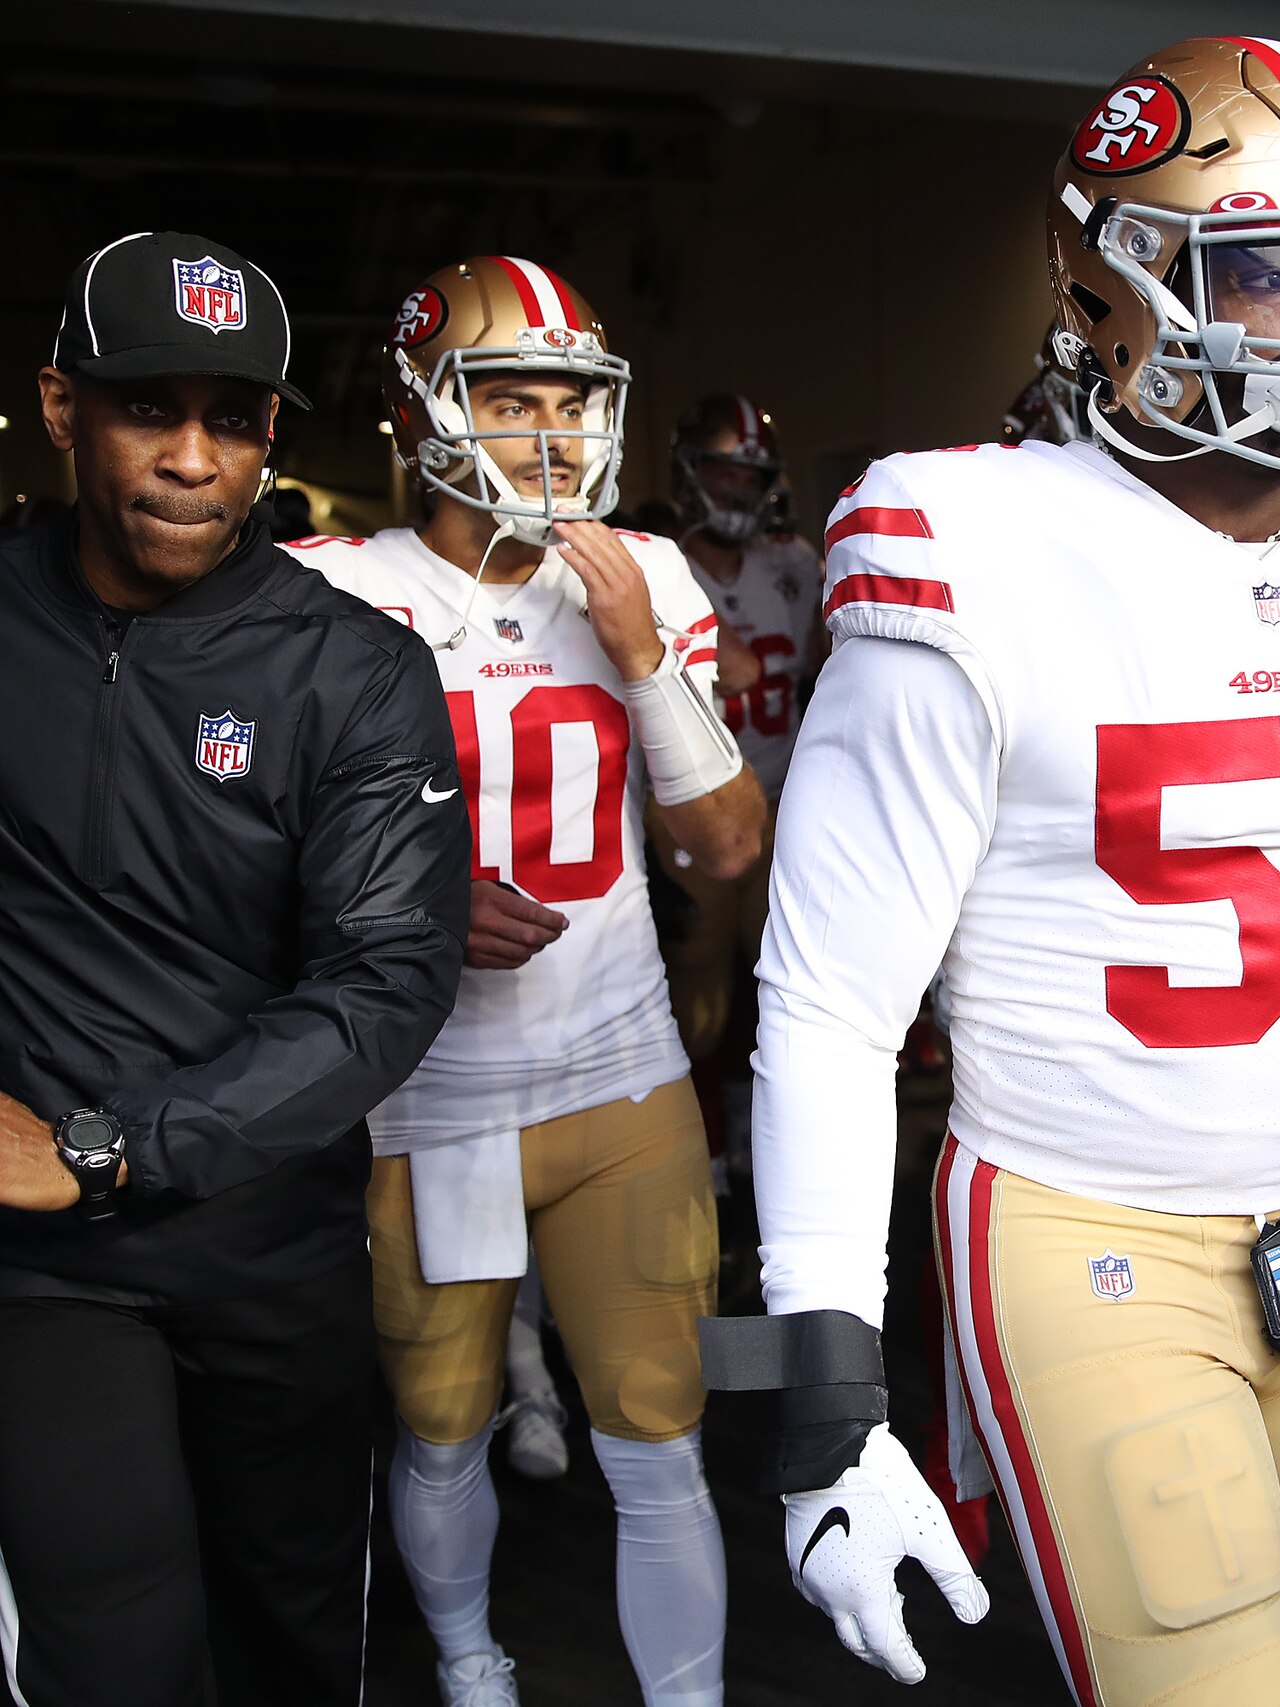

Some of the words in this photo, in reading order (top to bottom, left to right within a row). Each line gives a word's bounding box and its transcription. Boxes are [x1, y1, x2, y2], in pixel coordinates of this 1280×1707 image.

[183, 285, 240, 324] NFL
[478, 662, 554, 678] 49ERS
[202, 741, 244, 772] NFL
[1098, 1273, 1130, 1294] NFL
